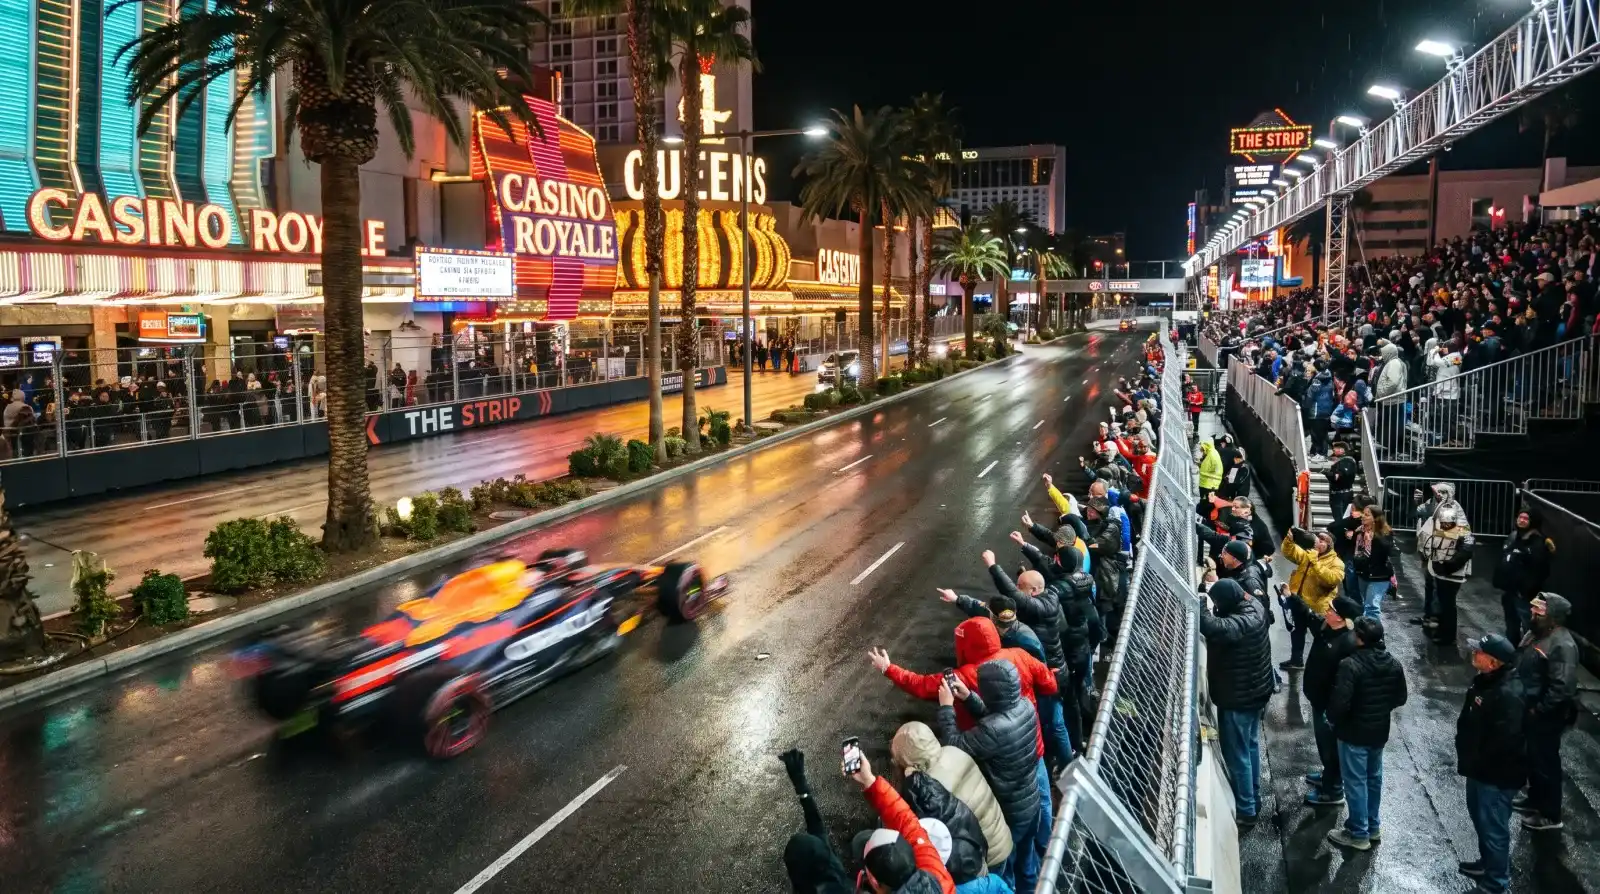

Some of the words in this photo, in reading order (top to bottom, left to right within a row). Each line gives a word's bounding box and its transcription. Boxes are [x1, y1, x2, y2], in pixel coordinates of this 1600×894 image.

[1238, 133, 1263, 148] THE
[1266, 131, 1305, 147] STRIP
[501, 173, 606, 221] CASINO
[27, 188, 233, 249] CASINO
[250, 208, 386, 256] ROYE
[512, 216, 615, 259] ROYALE
[405, 406, 454, 435] THE
[461, 397, 522, 426] STRIP
